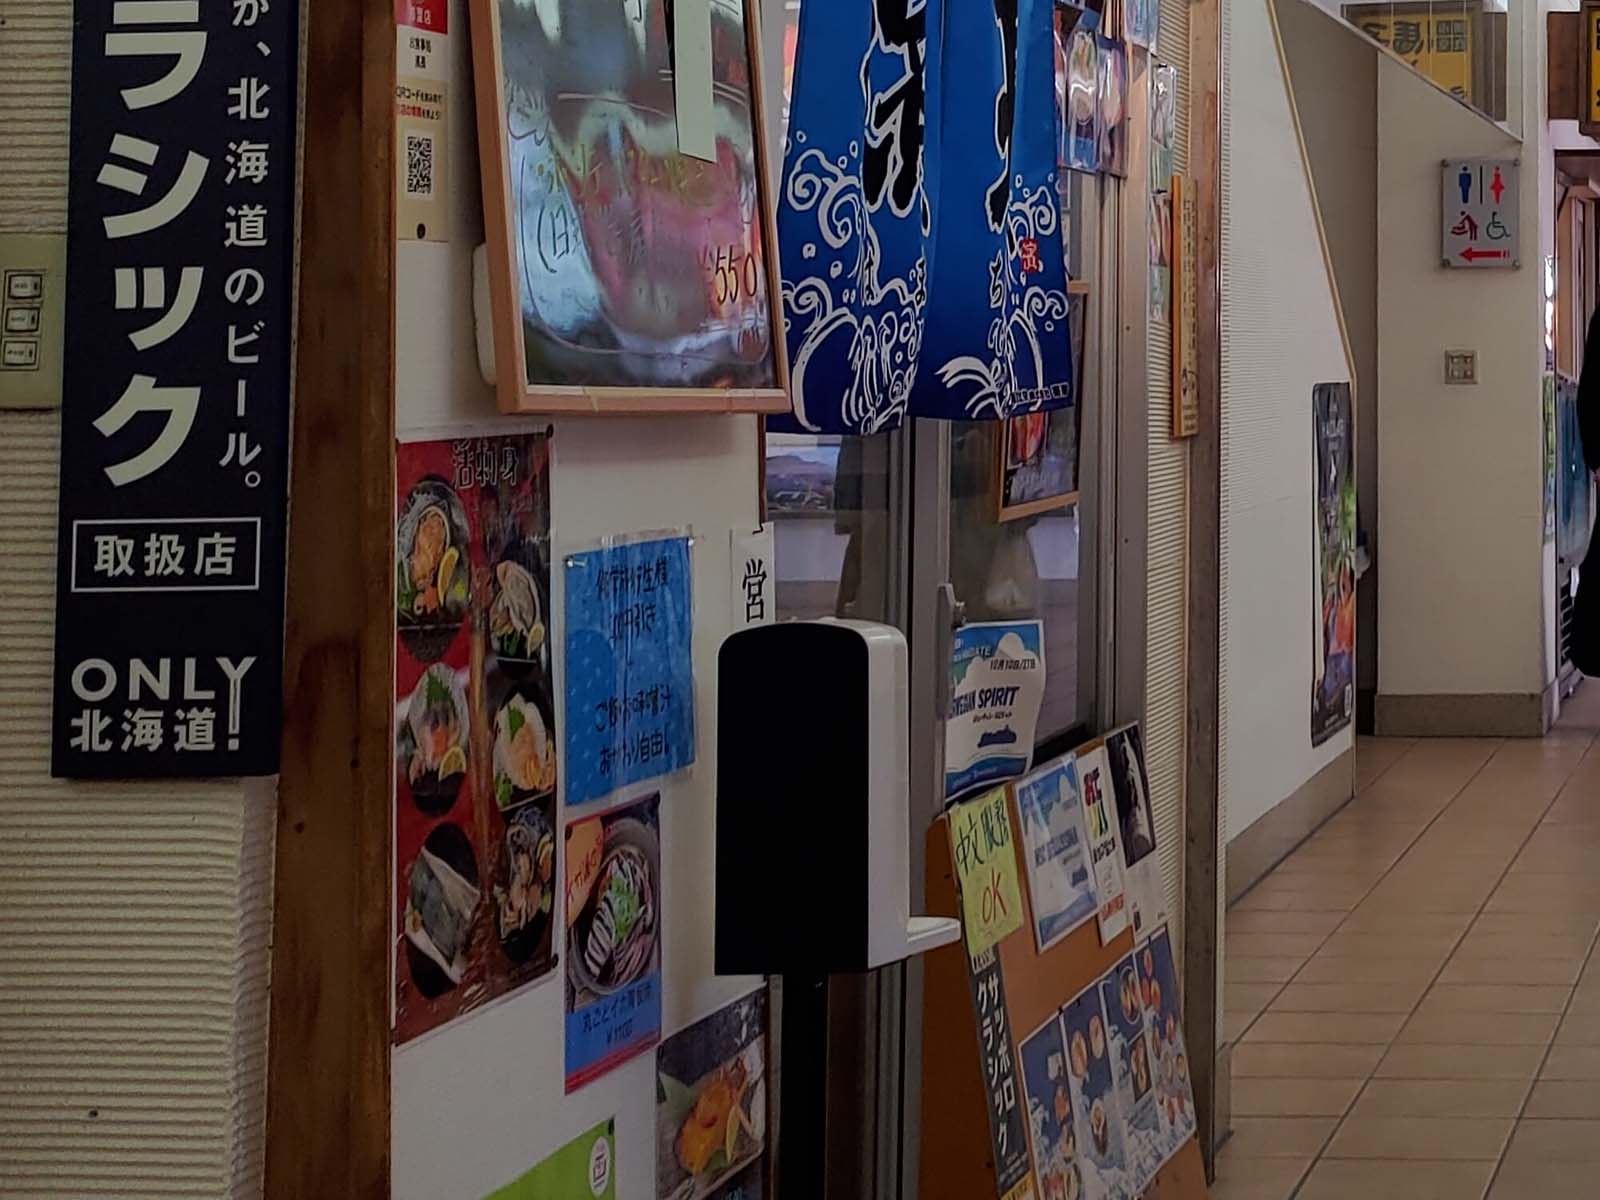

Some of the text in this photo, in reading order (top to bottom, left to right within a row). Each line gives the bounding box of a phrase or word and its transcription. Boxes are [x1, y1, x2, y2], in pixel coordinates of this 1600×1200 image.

[451, 439, 519, 490] 活刺身
[93, 532, 237, 577] 取扱店
[71, 656, 257, 702] ONLY
[977, 685, 1022, 709] SPIRIT
[982, 867, 1007, 924] OK
[987, 972, 1016, 1113] サッポロ
[977, 981, 1009, 1158] クラシック
